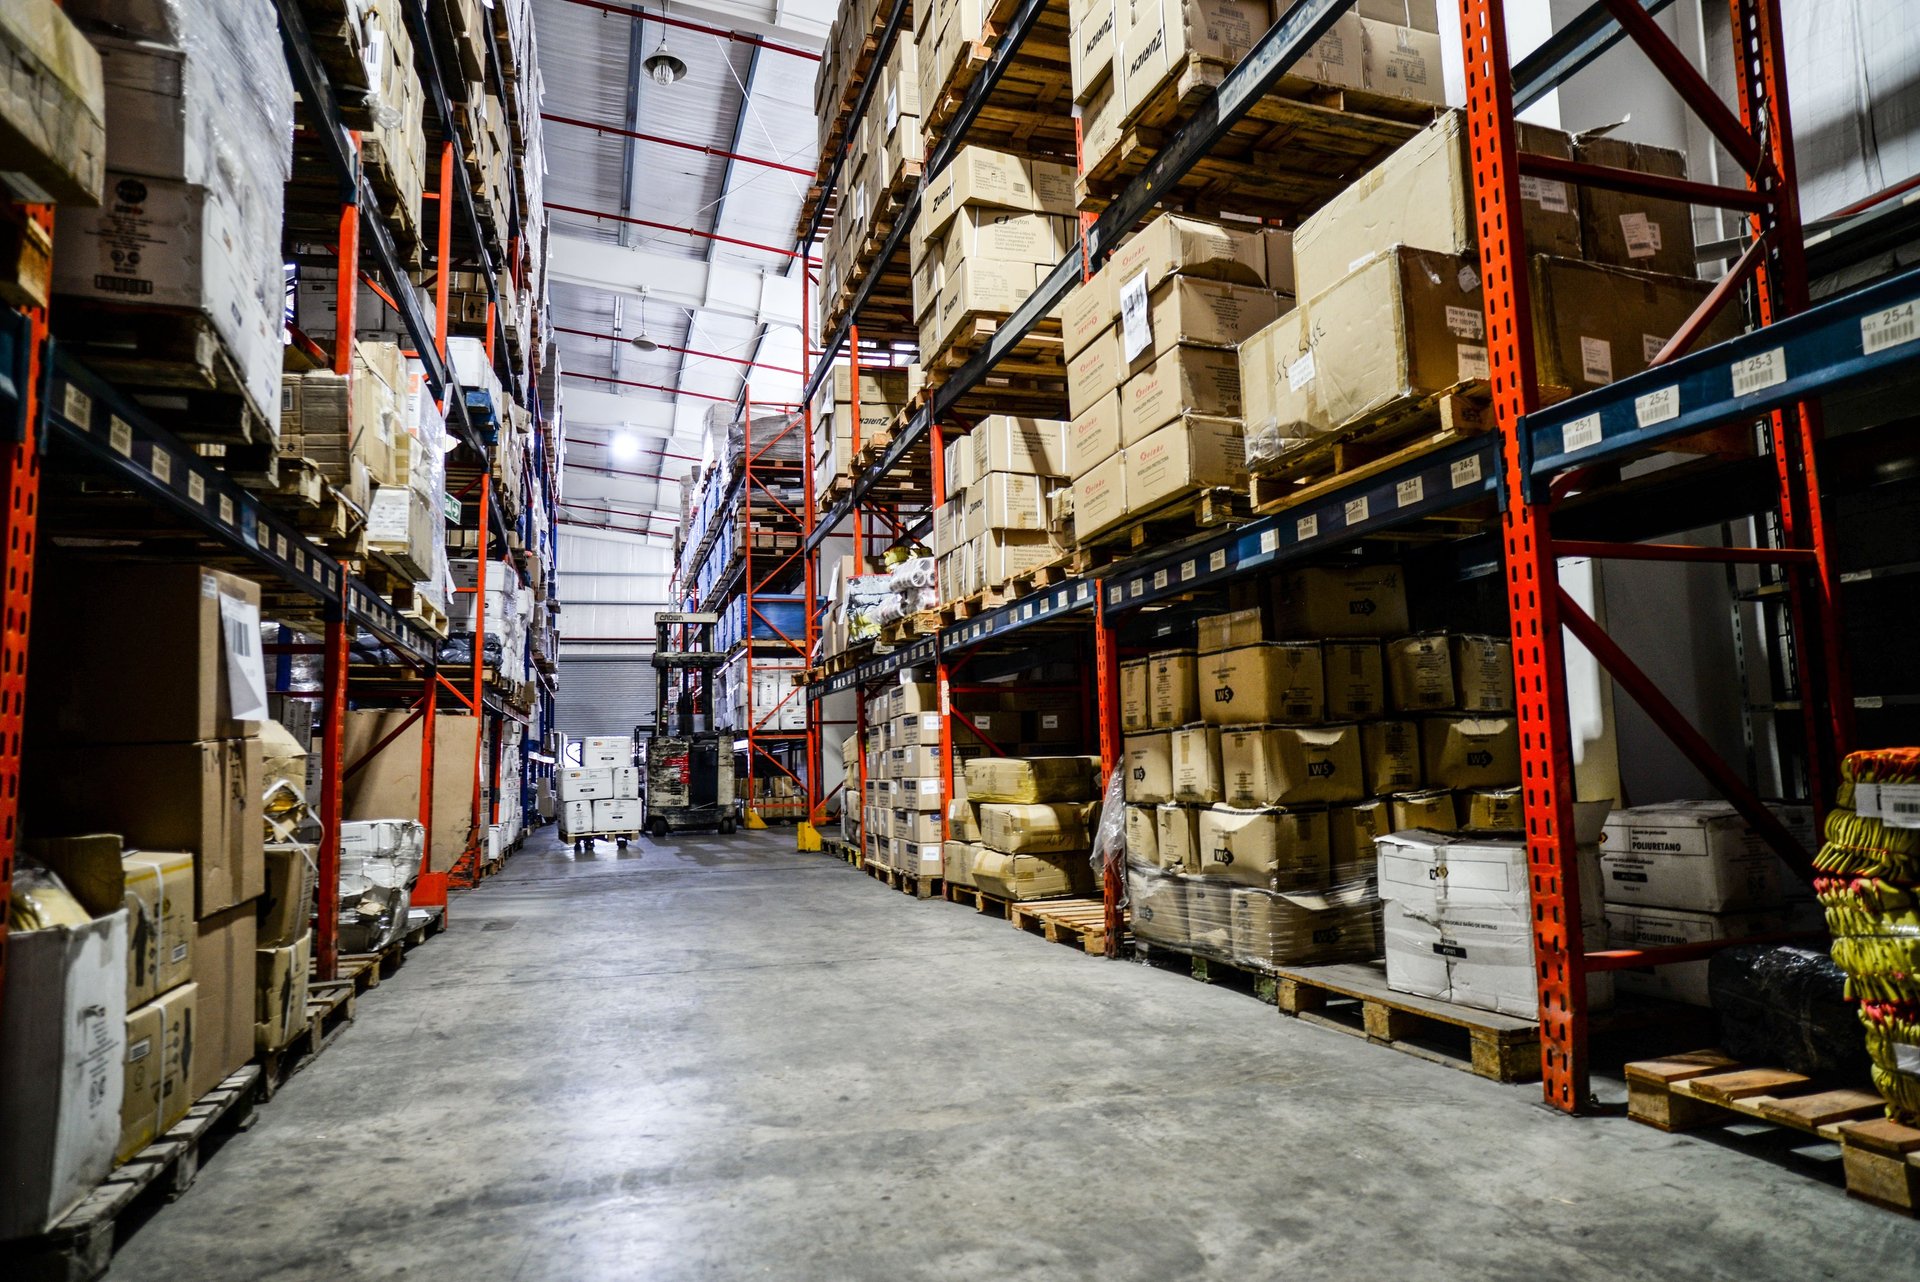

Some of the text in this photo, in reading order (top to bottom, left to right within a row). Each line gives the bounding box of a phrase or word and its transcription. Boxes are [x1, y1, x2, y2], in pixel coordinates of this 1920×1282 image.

[1883, 303, 1914, 327] 25-4
[1748, 353, 1773, 372] 25-3
[1649, 390, 1669, 407] 25-2
[1575, 418, 1592, 432] 25-1
[1460, 458, 1474, 470] 24-5
[1404, 479, 1417, 491] 24-4
[1352, 602, 1370, 612] WS
[1216, 688, 1230, 700] WS
[1470, 753, 1487, 764] WS
[1311, 764, 1330, 775] WS
[1632, 841, 1681, 852] POLIURETANO
[1215, 849, 1229, 862] WS
